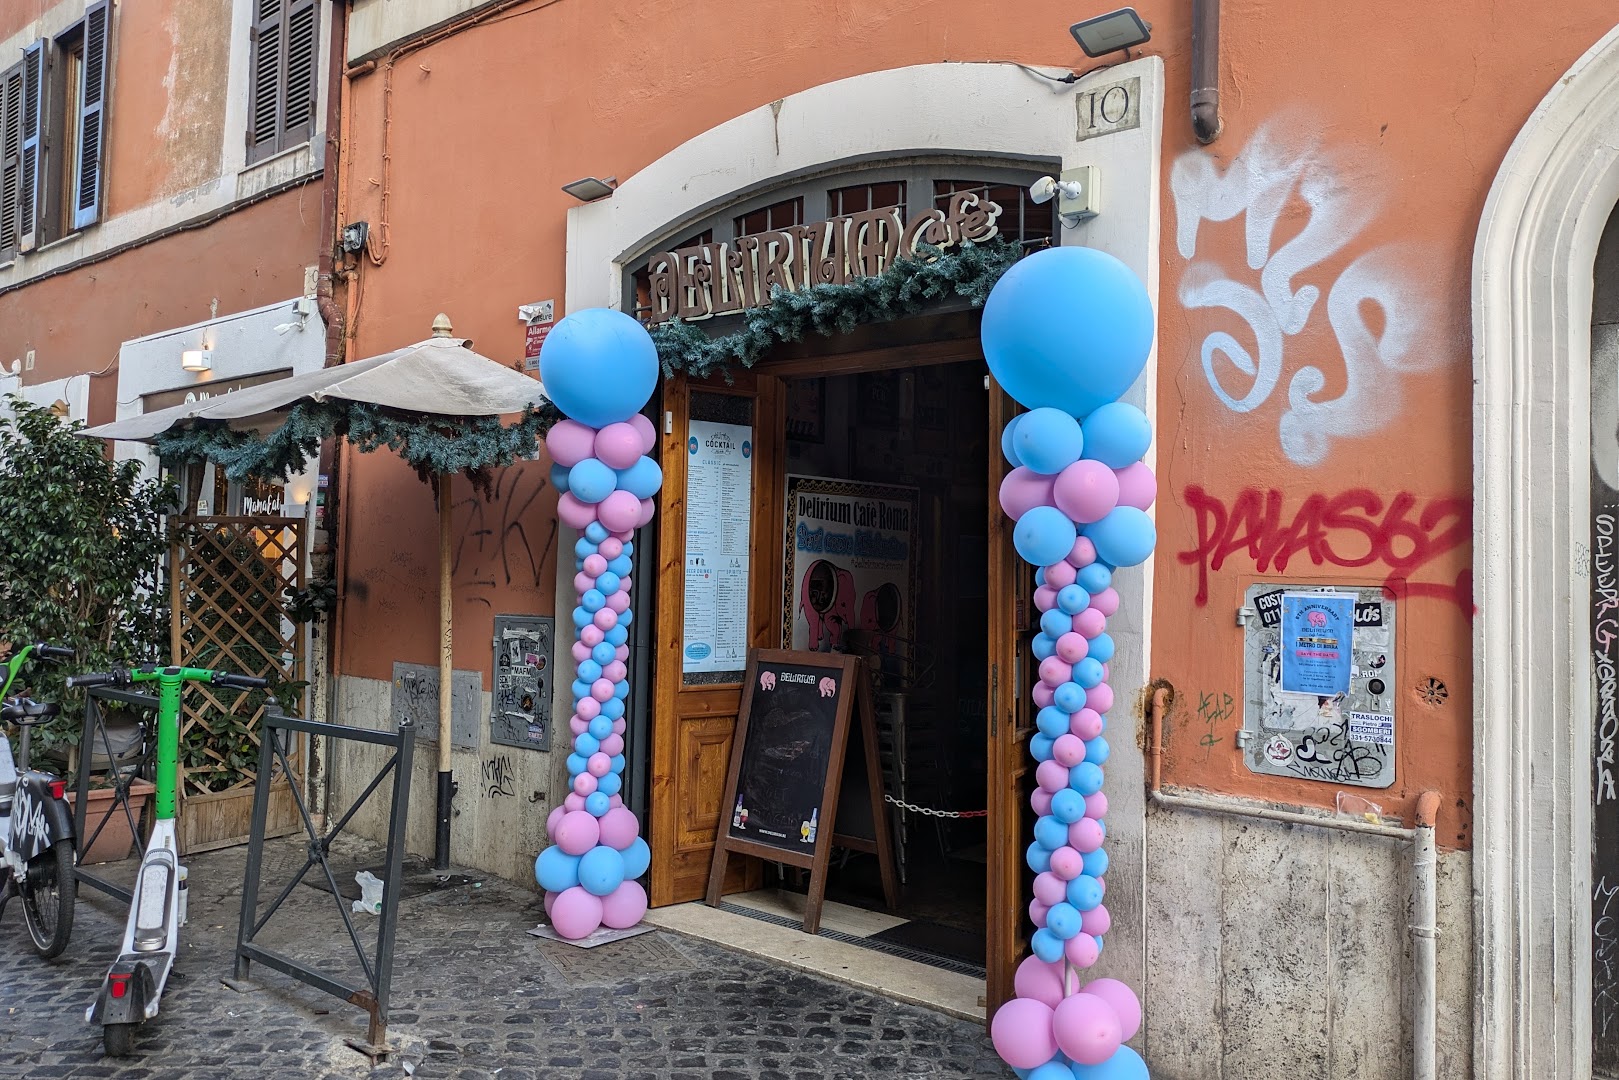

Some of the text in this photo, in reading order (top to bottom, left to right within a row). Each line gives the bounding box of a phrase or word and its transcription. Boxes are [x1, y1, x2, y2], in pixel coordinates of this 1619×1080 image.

[1087, 86, 1129, 129] 10
[649, 207, 900, 323] DELIRIUM
[705, 440, 736, 449] COCKTAIL
[798, 496, 851, 525] Delirium
[879, 502, 909, 532] Roma
[1304, 604, 1340, 621] ANNIVERSARY
[1351, 713, 1392, 722] TRASLOCHI
[1352, 726, 1391, 735] SGOMBERI
